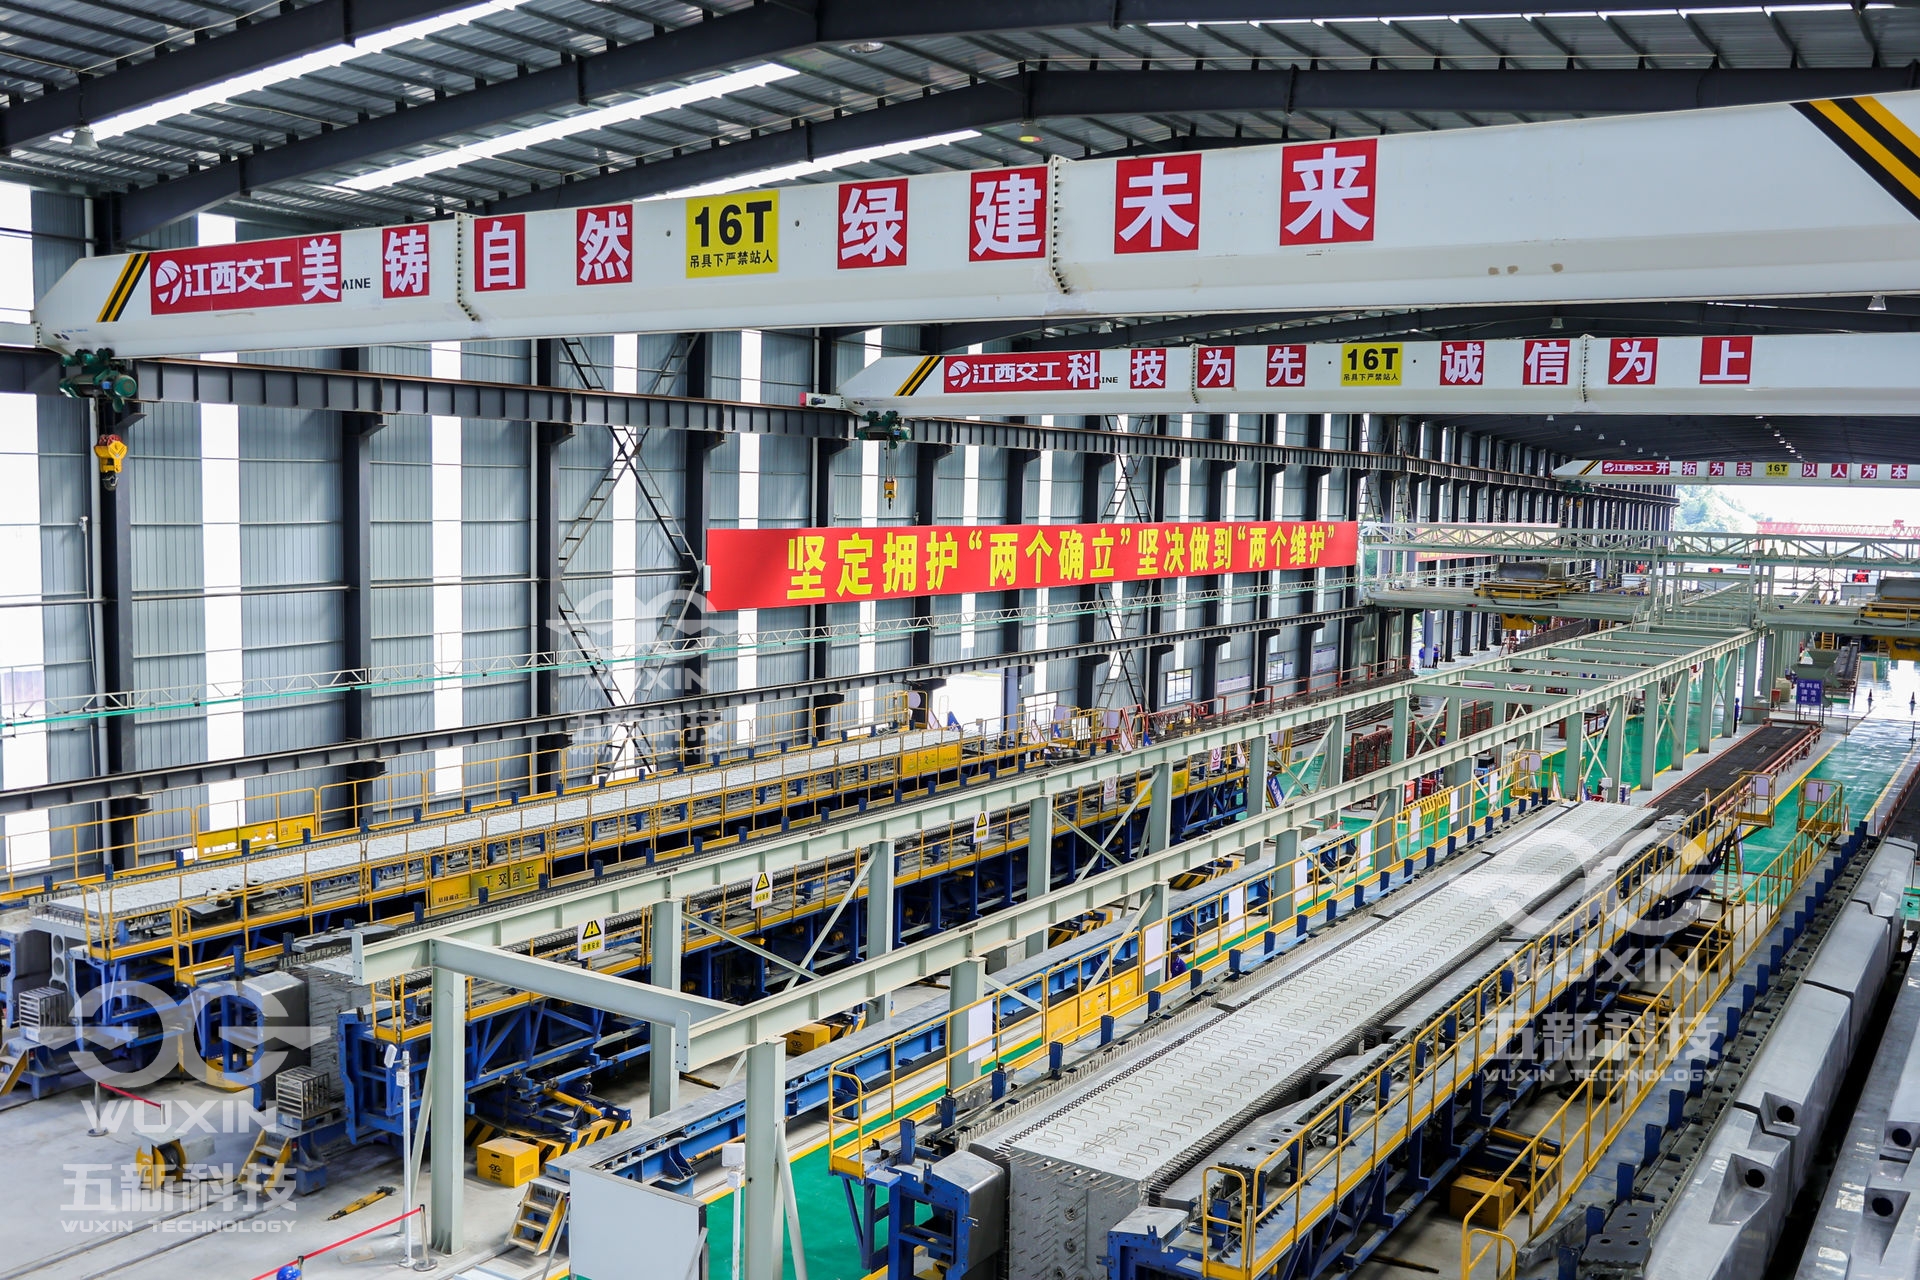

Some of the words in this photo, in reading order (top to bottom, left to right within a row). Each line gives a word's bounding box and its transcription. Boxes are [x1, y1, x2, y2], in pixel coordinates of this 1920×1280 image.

[695, 200, 772, 247] 16T
[690, 249, 773, 269] 吊具下严禁站人
[184, 256, 292, 297] 江西交工
[1347, 348, 1398, 370] 16T
[973, 361, 1061, 384] 江西交工
[1768, 464, 1787, 472] 16T
